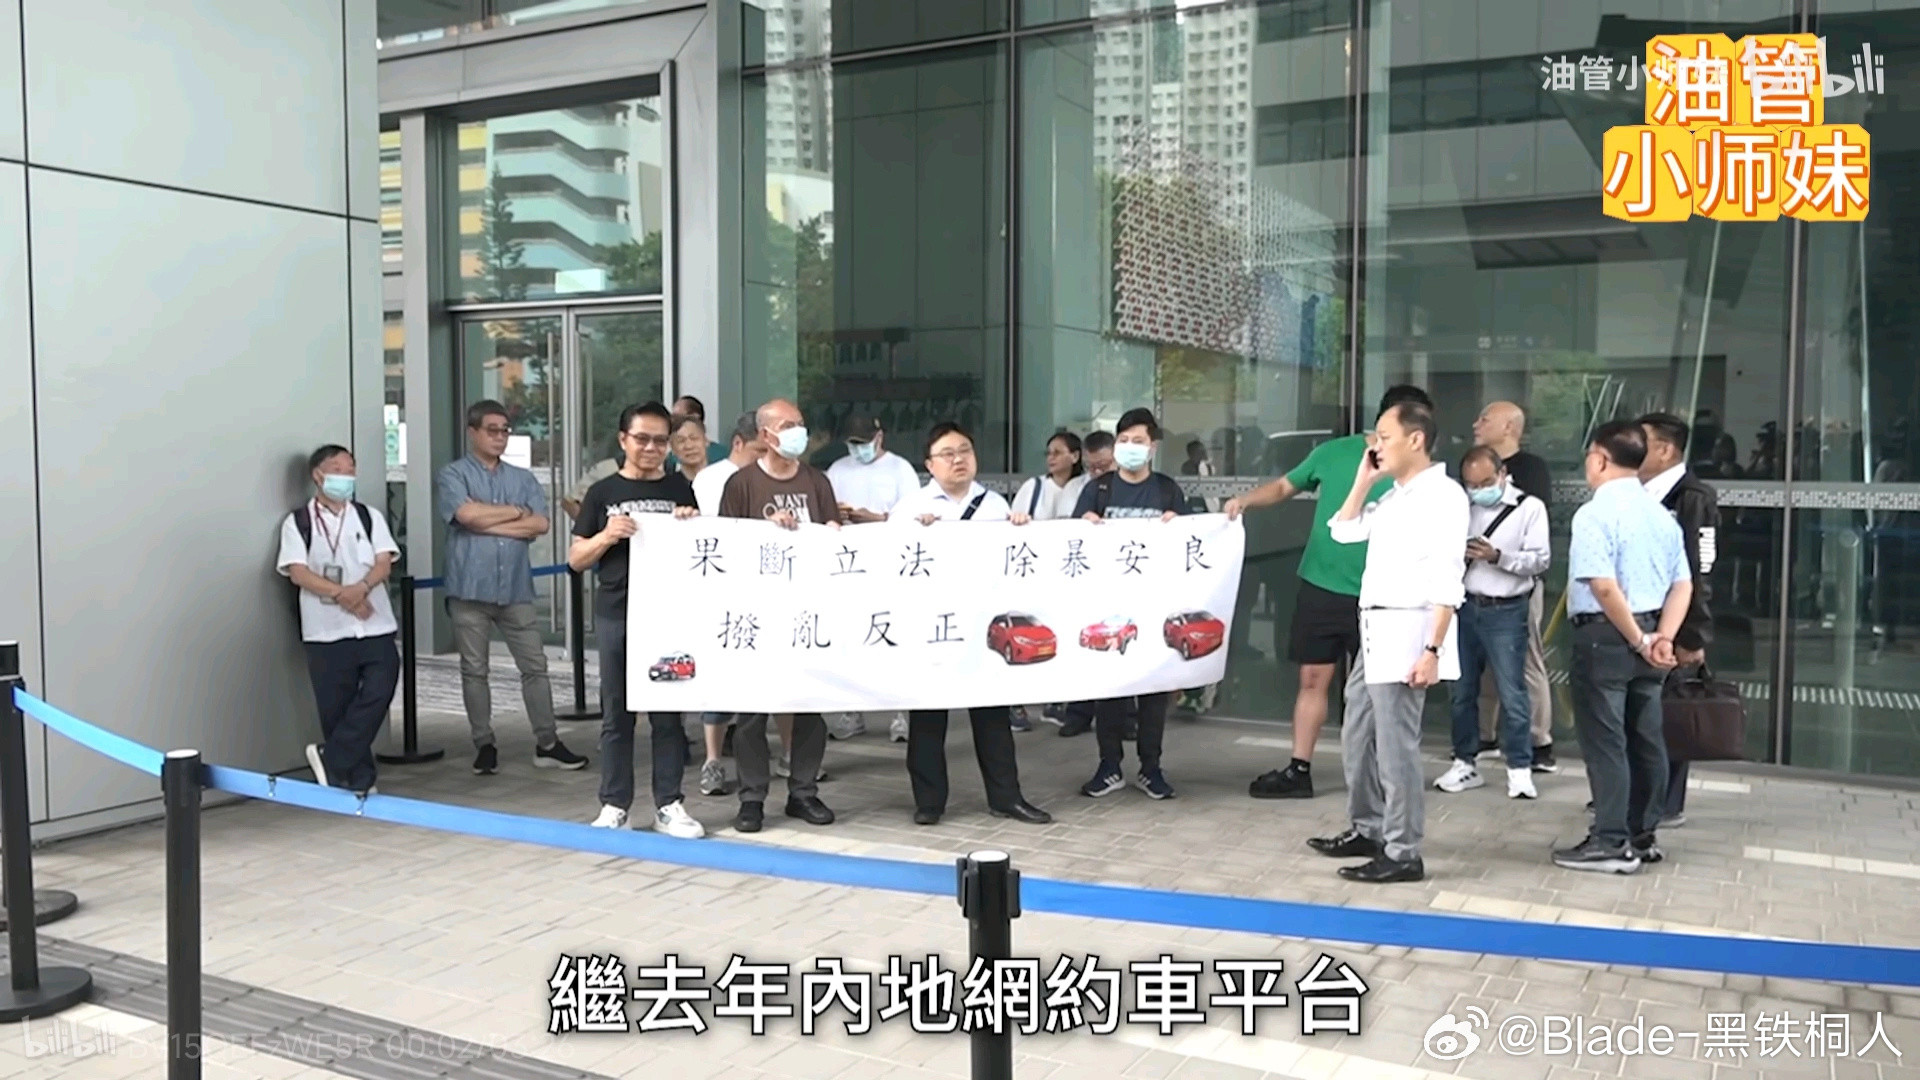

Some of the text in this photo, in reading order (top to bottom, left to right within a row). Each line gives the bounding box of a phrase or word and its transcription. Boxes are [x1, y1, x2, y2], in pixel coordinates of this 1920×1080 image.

[689, 535, 1212, 582] 果斷立法 除暴安良
[717, 610, 966, 651] 撥亂反正
